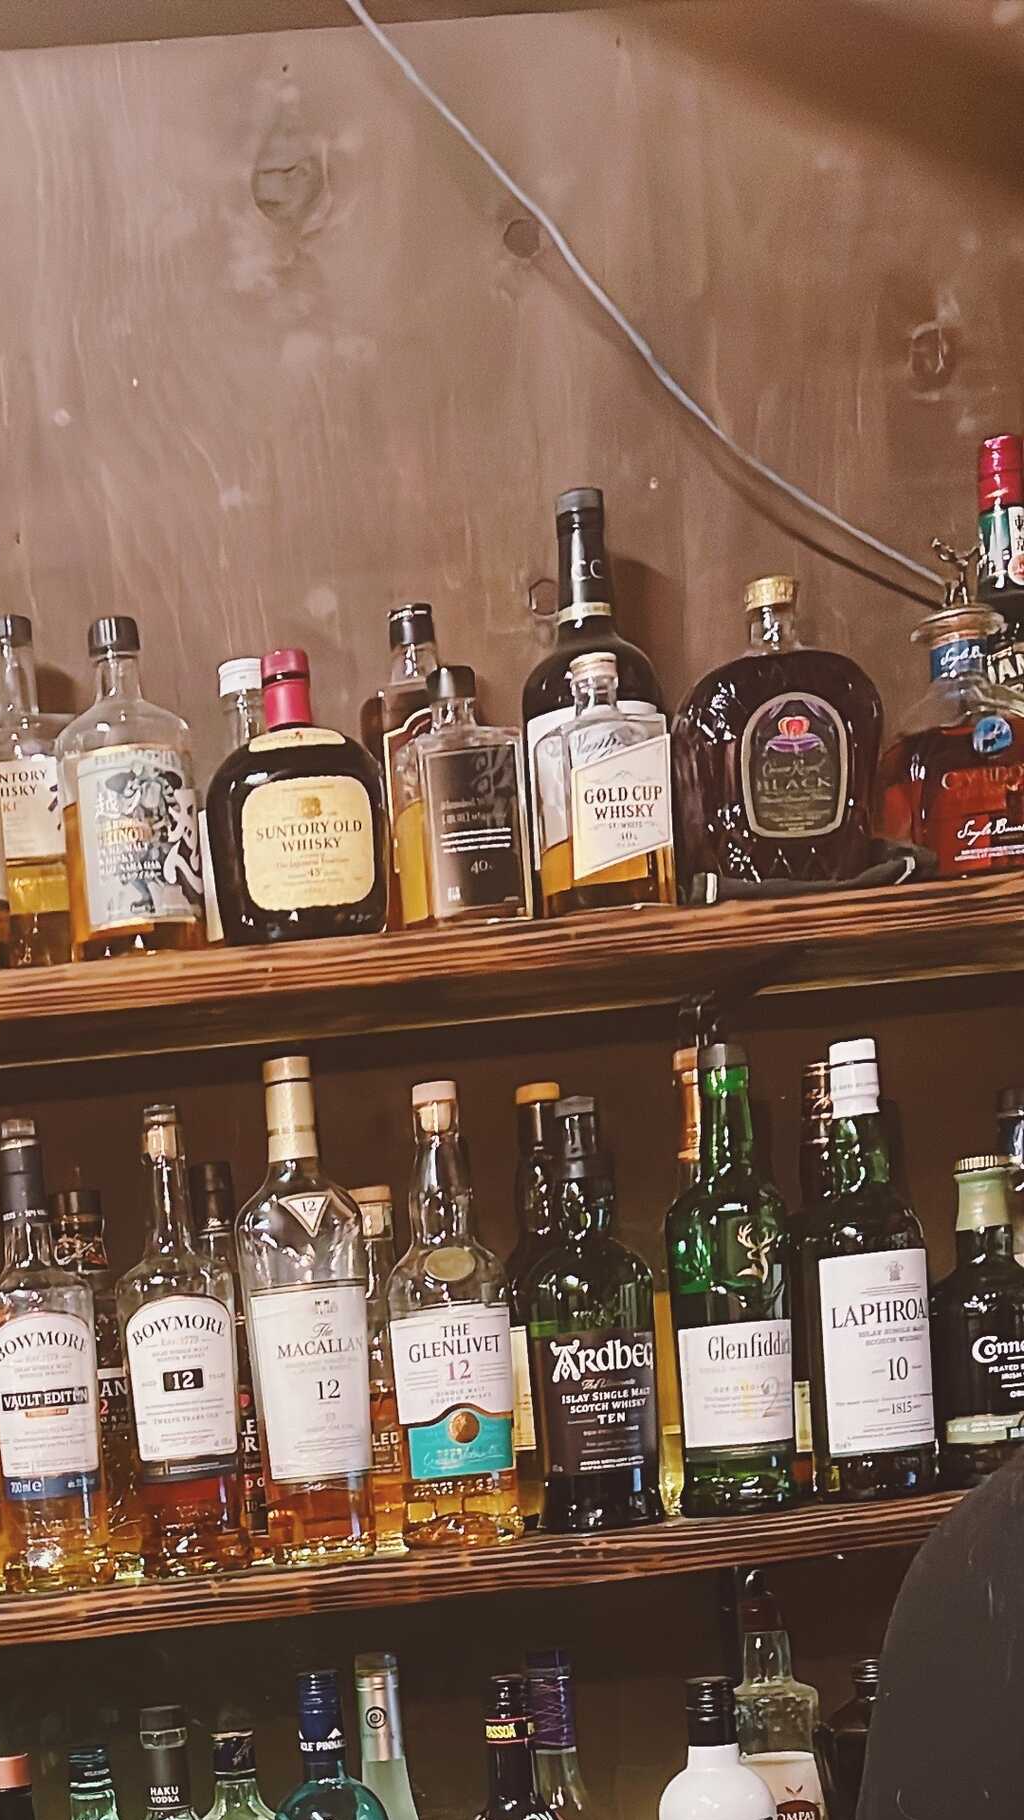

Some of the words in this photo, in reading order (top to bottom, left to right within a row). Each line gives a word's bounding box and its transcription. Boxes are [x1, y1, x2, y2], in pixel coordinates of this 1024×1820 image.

[0, 768, 47, 784] NTORY
[0, 784, 37, 798] ISKY
[584, 785, 628, 805] GOLD
[632, 784, 663, 802] CUP
[594, 803, 656, 821] WHISKY
[256, 820, 328, 842] SUNTORY
[333, 819, 362, 834] OLD
[281, 836, 343, 853] WHISKY
[831, 1297, 928, 1330] LAPHROA
[132, 1314, 225, 1346] BOWMORE
[312, 1322, 334, 1339] The
[440, 1322, 470, 1339] THE
[277, 1336, 363, 1360] MACALLAN
[409, 1334, 501, 1364] GLENLIVET
[448, 1359, 472, 1381] 12
[888, 1356, 909, 1382] 10
[988, 1363, 1020, 1374] PEATED
[171, 1370, 195, 1390] 12
[316, 1378, 341, 1401] 12
[561, 1393, 591, 1405] ISLAY
[593, 1389, 629, 1402] SINGLE
[631, 1386, 651, 1397] MALT
[3, 1391, 43, 1409] VAULT
[570, 1401, 610, 1415] SCOTCH
[612, 1397, 647, 1411] WHISKY
[891, 1401, 913, 1415] 1815
[597, 1411, 627, 1426] TEN
[372, 1431, 400, 1447] LED
[150, 1785, 179, 1797] HAKU
[150, 1795, 180, 1804] VODKA
